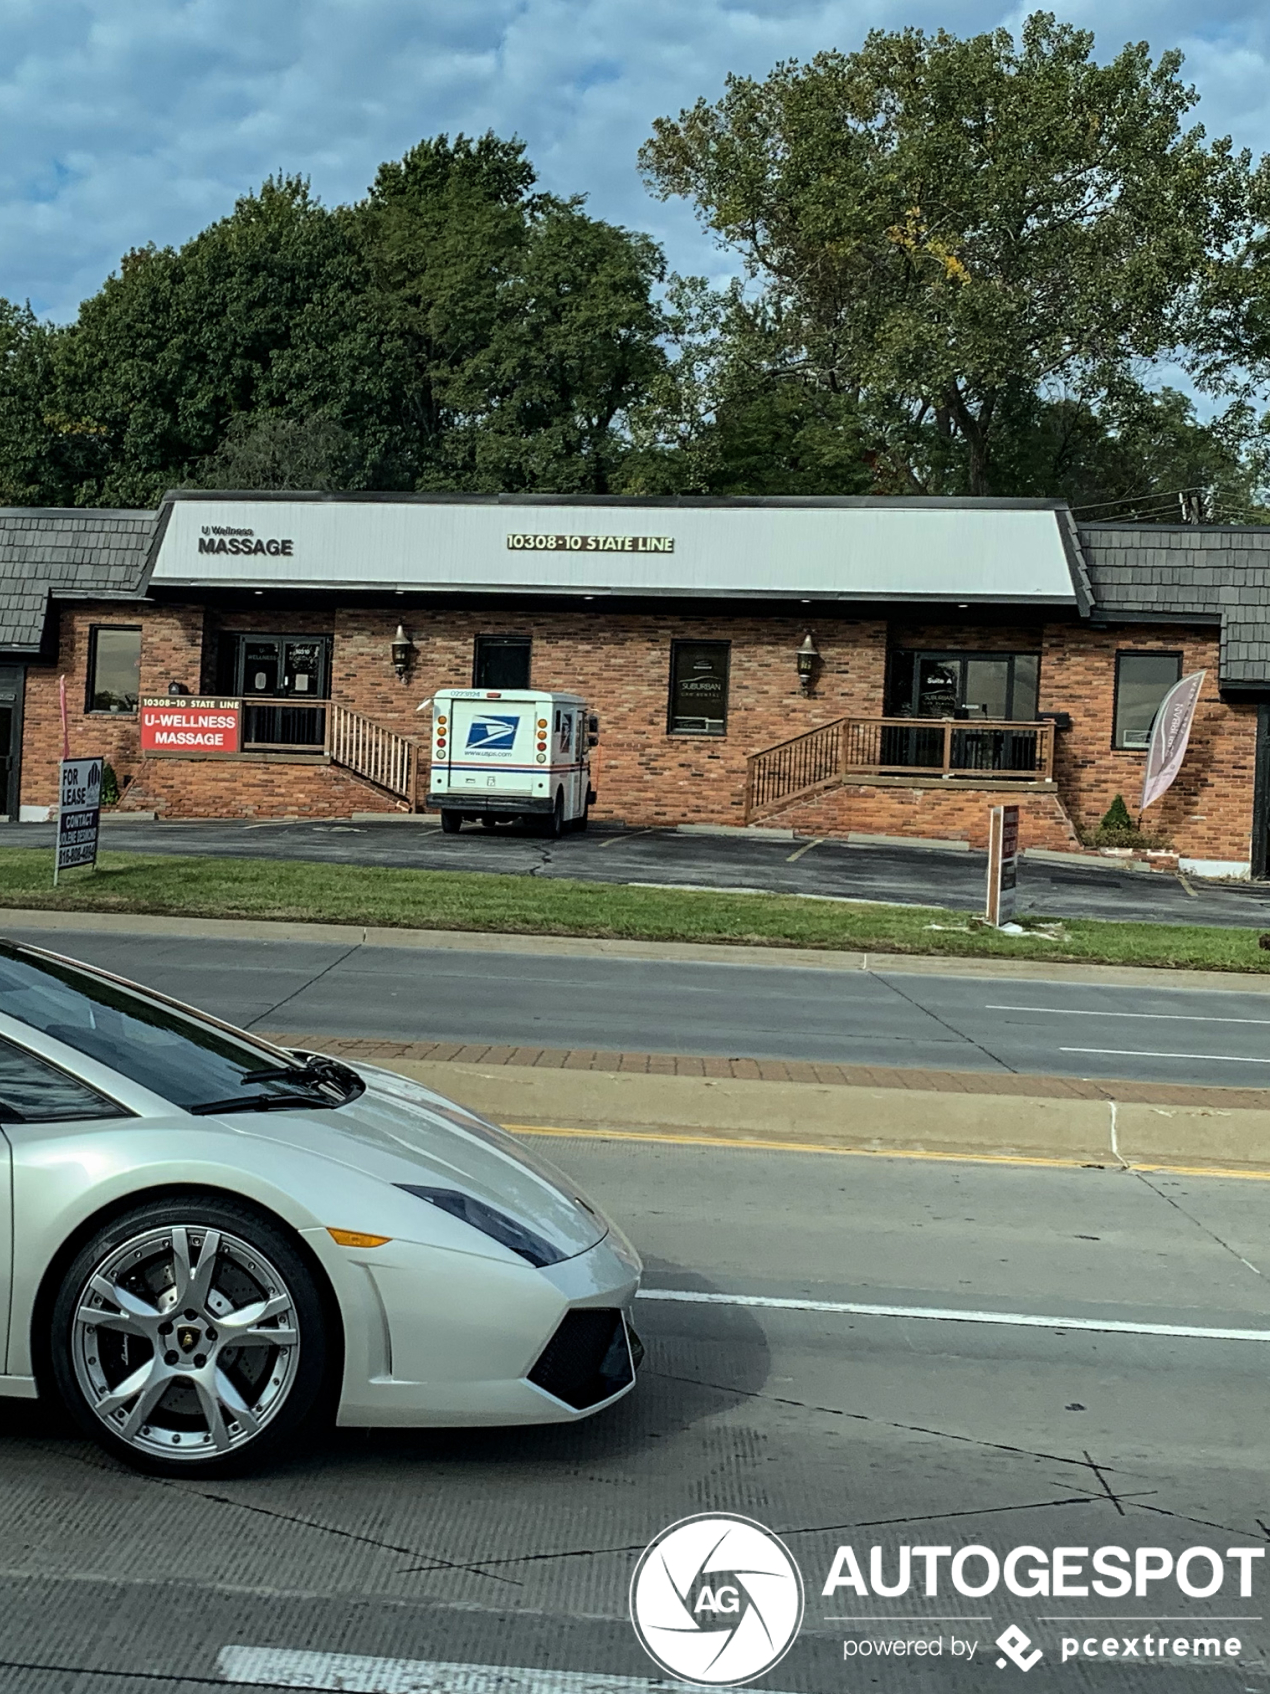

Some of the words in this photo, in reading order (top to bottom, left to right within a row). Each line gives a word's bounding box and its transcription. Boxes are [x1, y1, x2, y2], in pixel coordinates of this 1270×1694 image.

[211, 526, 254, 537] Wellness
[198, 537, 294, 556] MASSAGE
[507, 535, 582, 550] 10308-10
[586, 536, 633, 551] STATE
[637, 537, 674, 552] LINE
[681, 682, 722, 691] SUBURBAN
[143, 698, 187, 708] 10308-10
[190, 700, 216, 709] STATE
[219, 701, 240, 710] LINE
[144, 713, 236, 729] U-WELLNESS
[155, 731, 224, 746] MASSAGE
[464, 750, 513, 758] www.usps.com
[63, 768, 79, 786] FOR
[62, 787, 86, 807] LEASE
[65, 812, 94, 829] CONTACT
